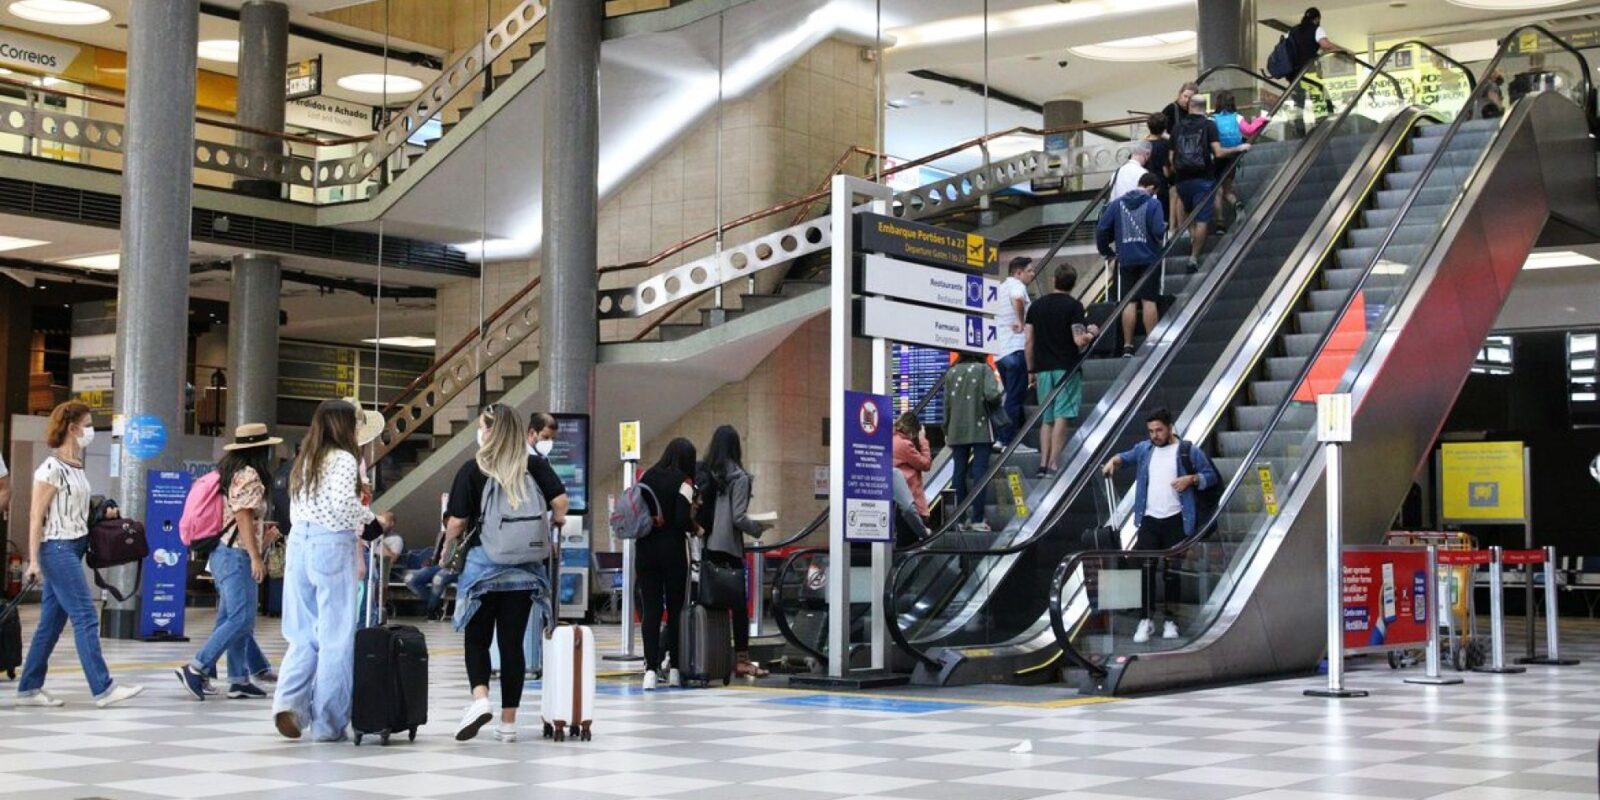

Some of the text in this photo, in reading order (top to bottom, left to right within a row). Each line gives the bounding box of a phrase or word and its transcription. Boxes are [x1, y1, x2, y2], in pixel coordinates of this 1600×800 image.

[0, 43, 57, 68] Correios
[334, 105, 368, 120] Achados
[878, 221, 916, 240] Embarque
[918, 229, 945, 245] Portões
[956, 239, 965, 249] 27
[904, 243, 932, 256] Departure
[933, 248, 947, 259] Gates
[930, 278, 963, 291] Restaurante
